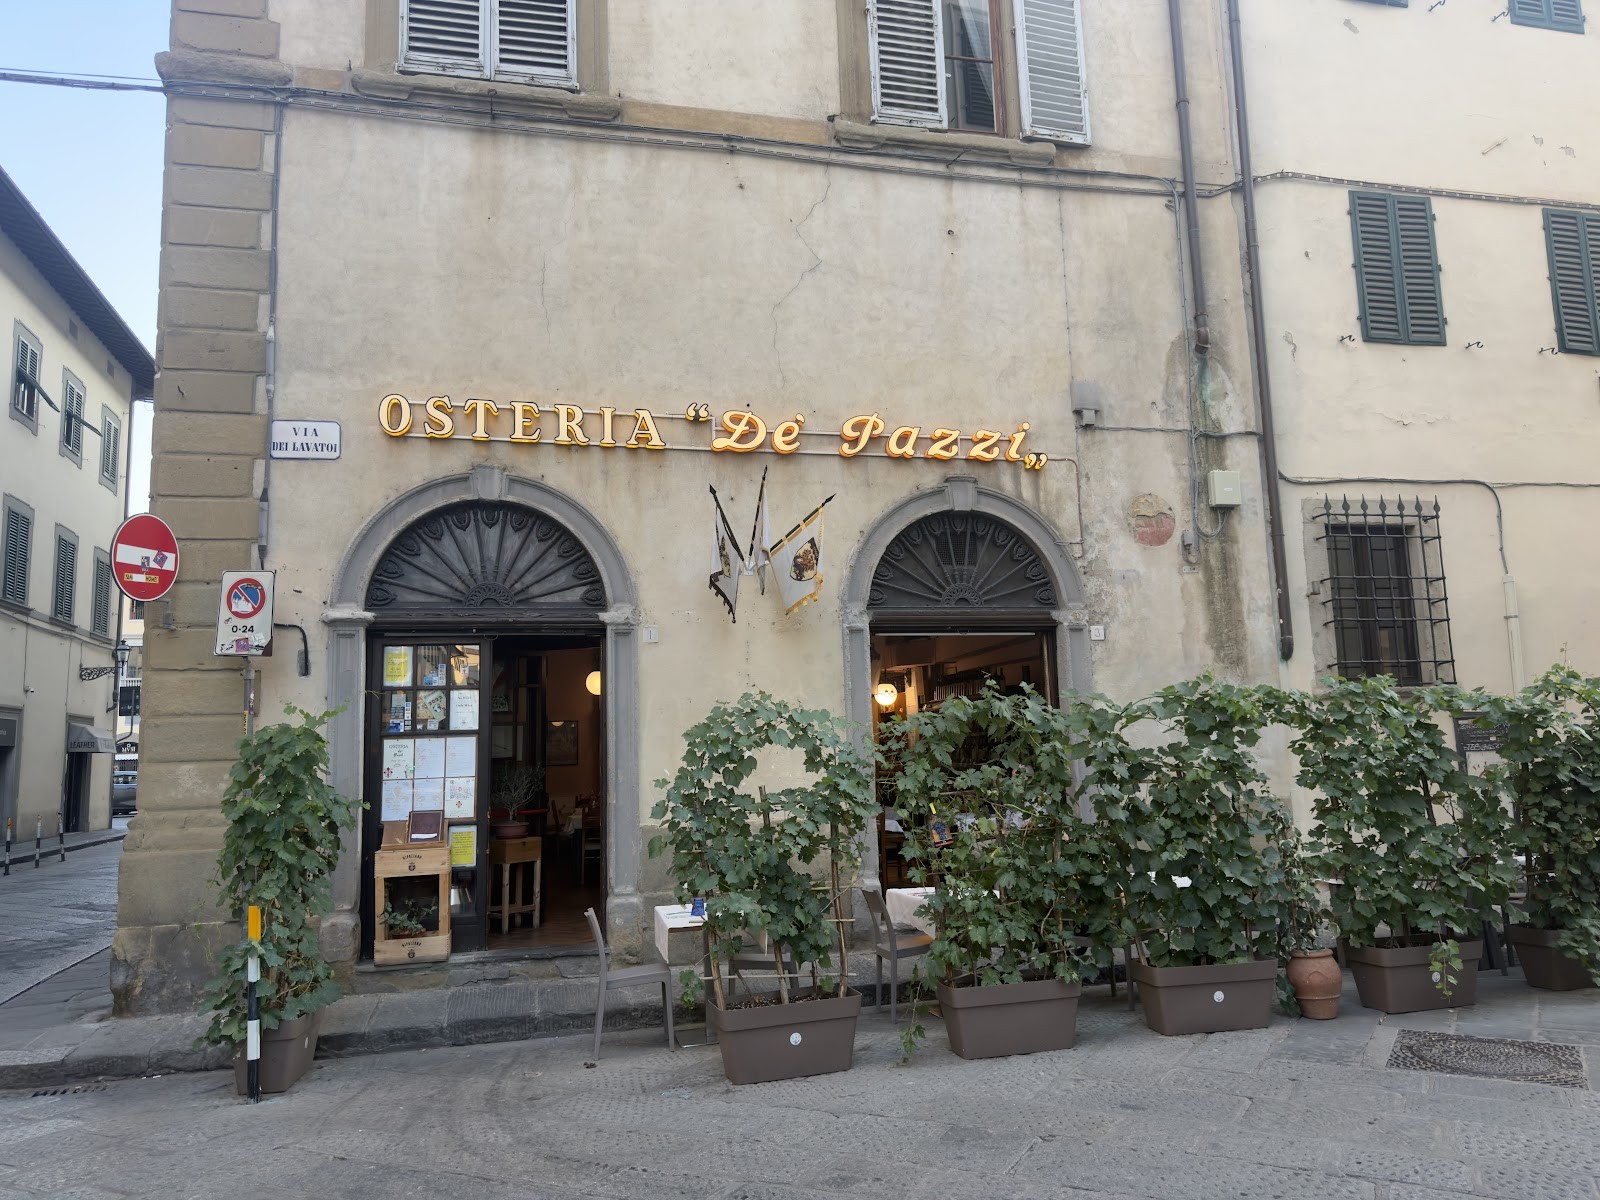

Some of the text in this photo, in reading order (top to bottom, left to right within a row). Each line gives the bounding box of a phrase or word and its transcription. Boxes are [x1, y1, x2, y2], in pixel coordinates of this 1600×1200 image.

[378, 394, 667, 450] OSTERIA
[292, 426, 319, 437] VIA
[272, 441, 337, 453] DEI LAVATOI
[231, 625, 255, 633] 0-24
[70, 741, 95, 749] LEATHER
